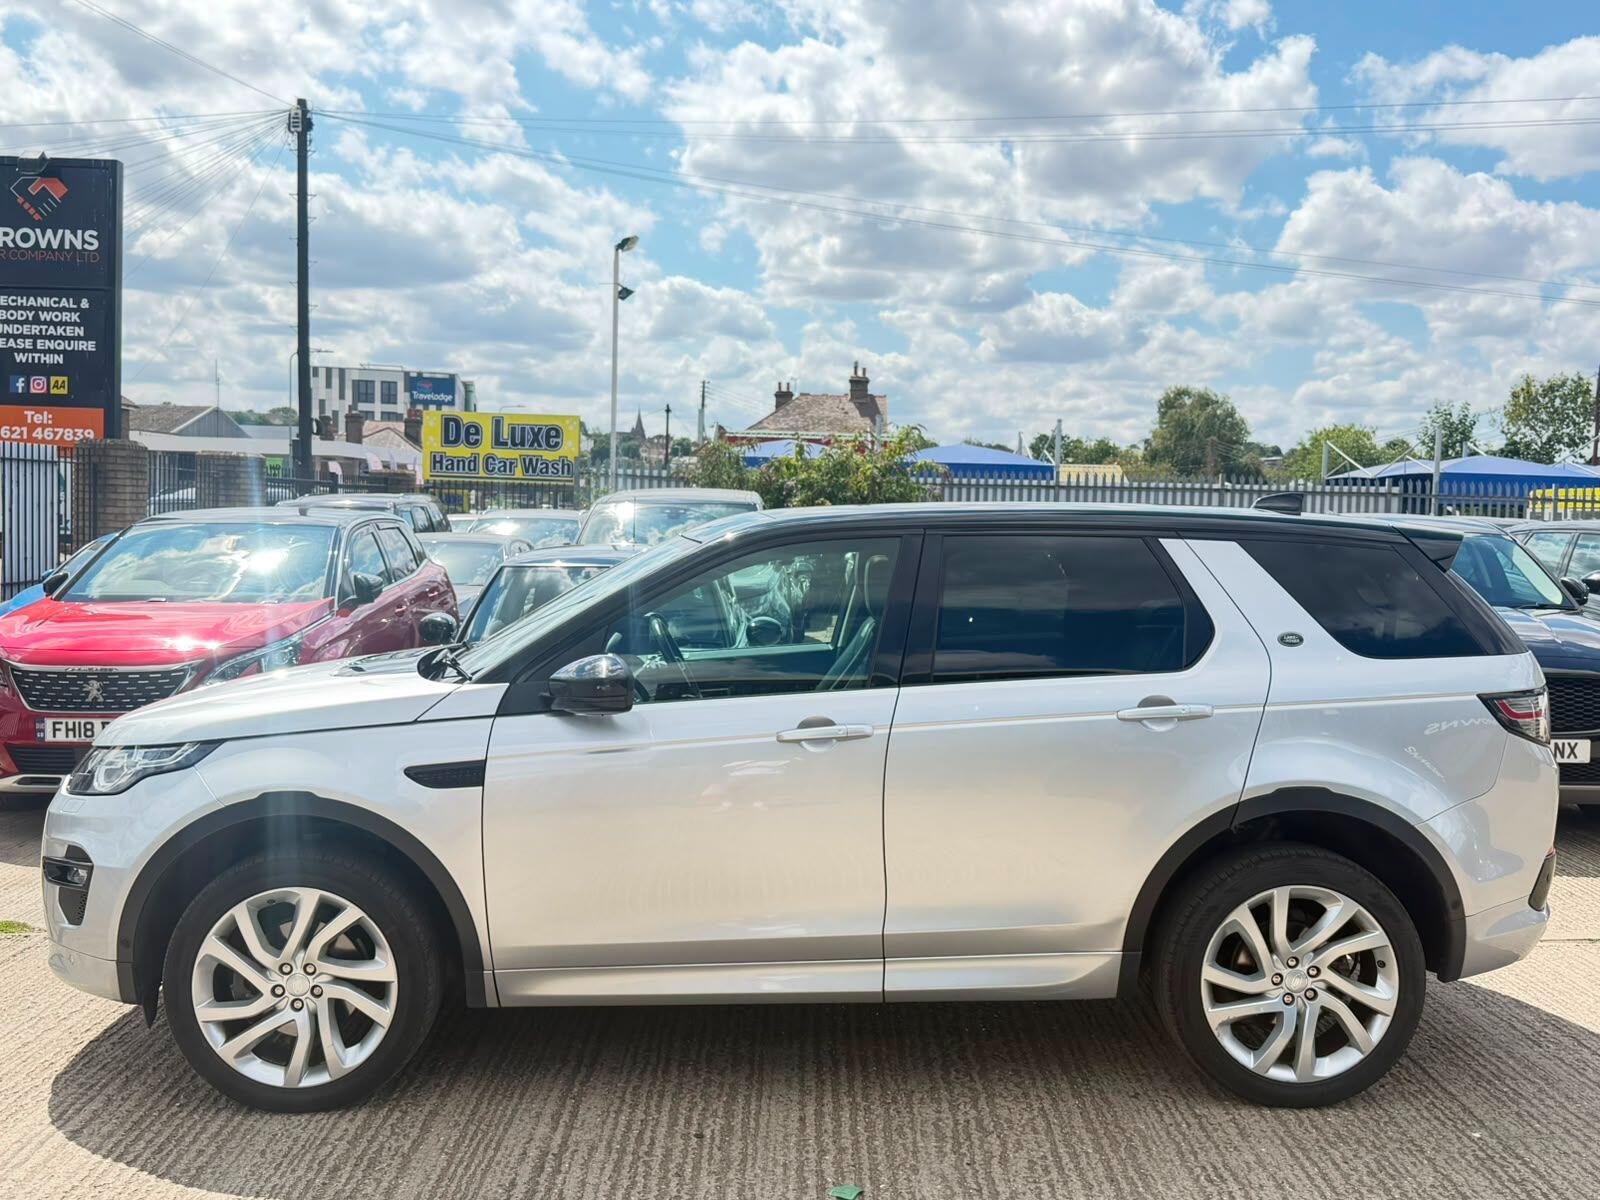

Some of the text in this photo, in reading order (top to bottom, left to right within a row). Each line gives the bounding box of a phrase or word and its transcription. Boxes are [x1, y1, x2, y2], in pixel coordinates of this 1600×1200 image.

[0, 227, 99, 250] ROWNS
[9, 249, 73, 262] COMPANY
[76, 251, 100, 263] LTD
[0, 296, 90, 309] ECHANICAL &
[0, 310, 80, 322] BODY WORK
[0, 324, 84, 337] NDERTAKEN
[0, 338, 96, 351] EASE ENQUIRE
[14, 352, 64, 364] WITHIN
[412, 391, 454, 402] Travelodge
[24, 410, 53, 424] Tel:
[0, 426, 95, 441] 621 467839
[441, 415, 563, 451] De Luxe
[430, 452, 574, 478] Hand Car Wash
[52, 721, 95, 738] FH18
[1553, 742, 1578, 759] NX
